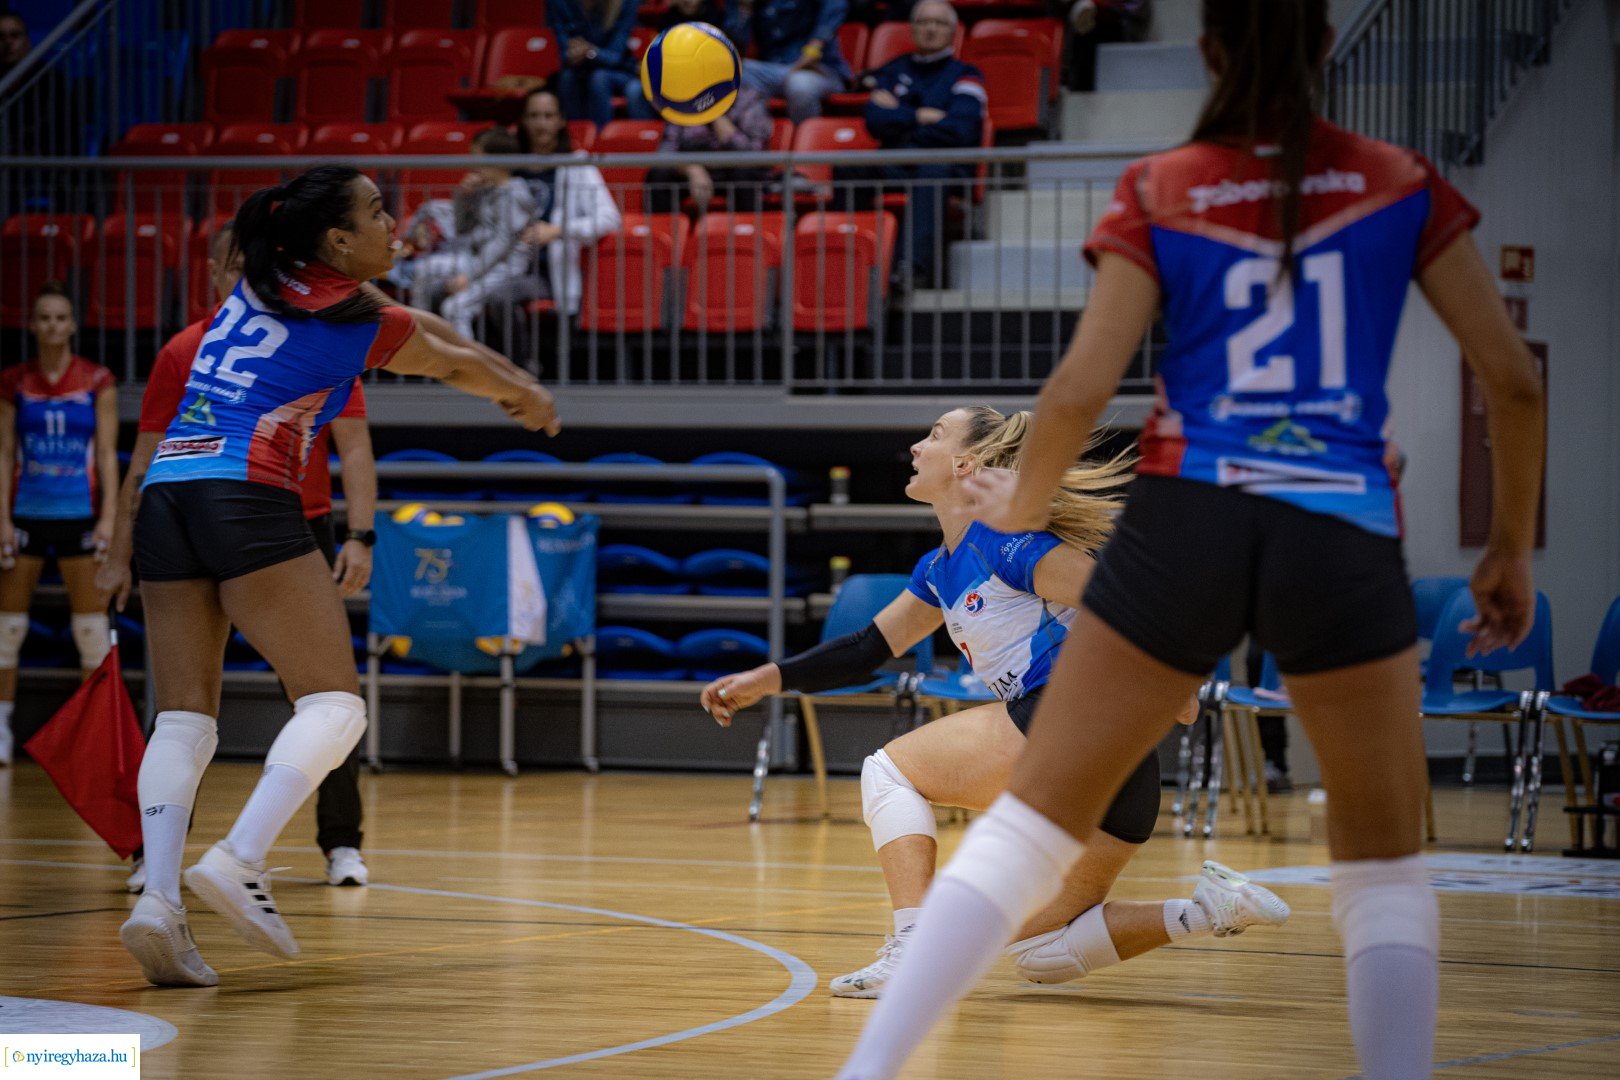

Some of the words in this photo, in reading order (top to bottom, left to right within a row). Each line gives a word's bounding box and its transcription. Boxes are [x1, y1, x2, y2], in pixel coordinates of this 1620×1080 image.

[190, 294, 290, 388] 22
[1224, 250, 1348, 392] 21
[44, 409, 66, 436] 11
